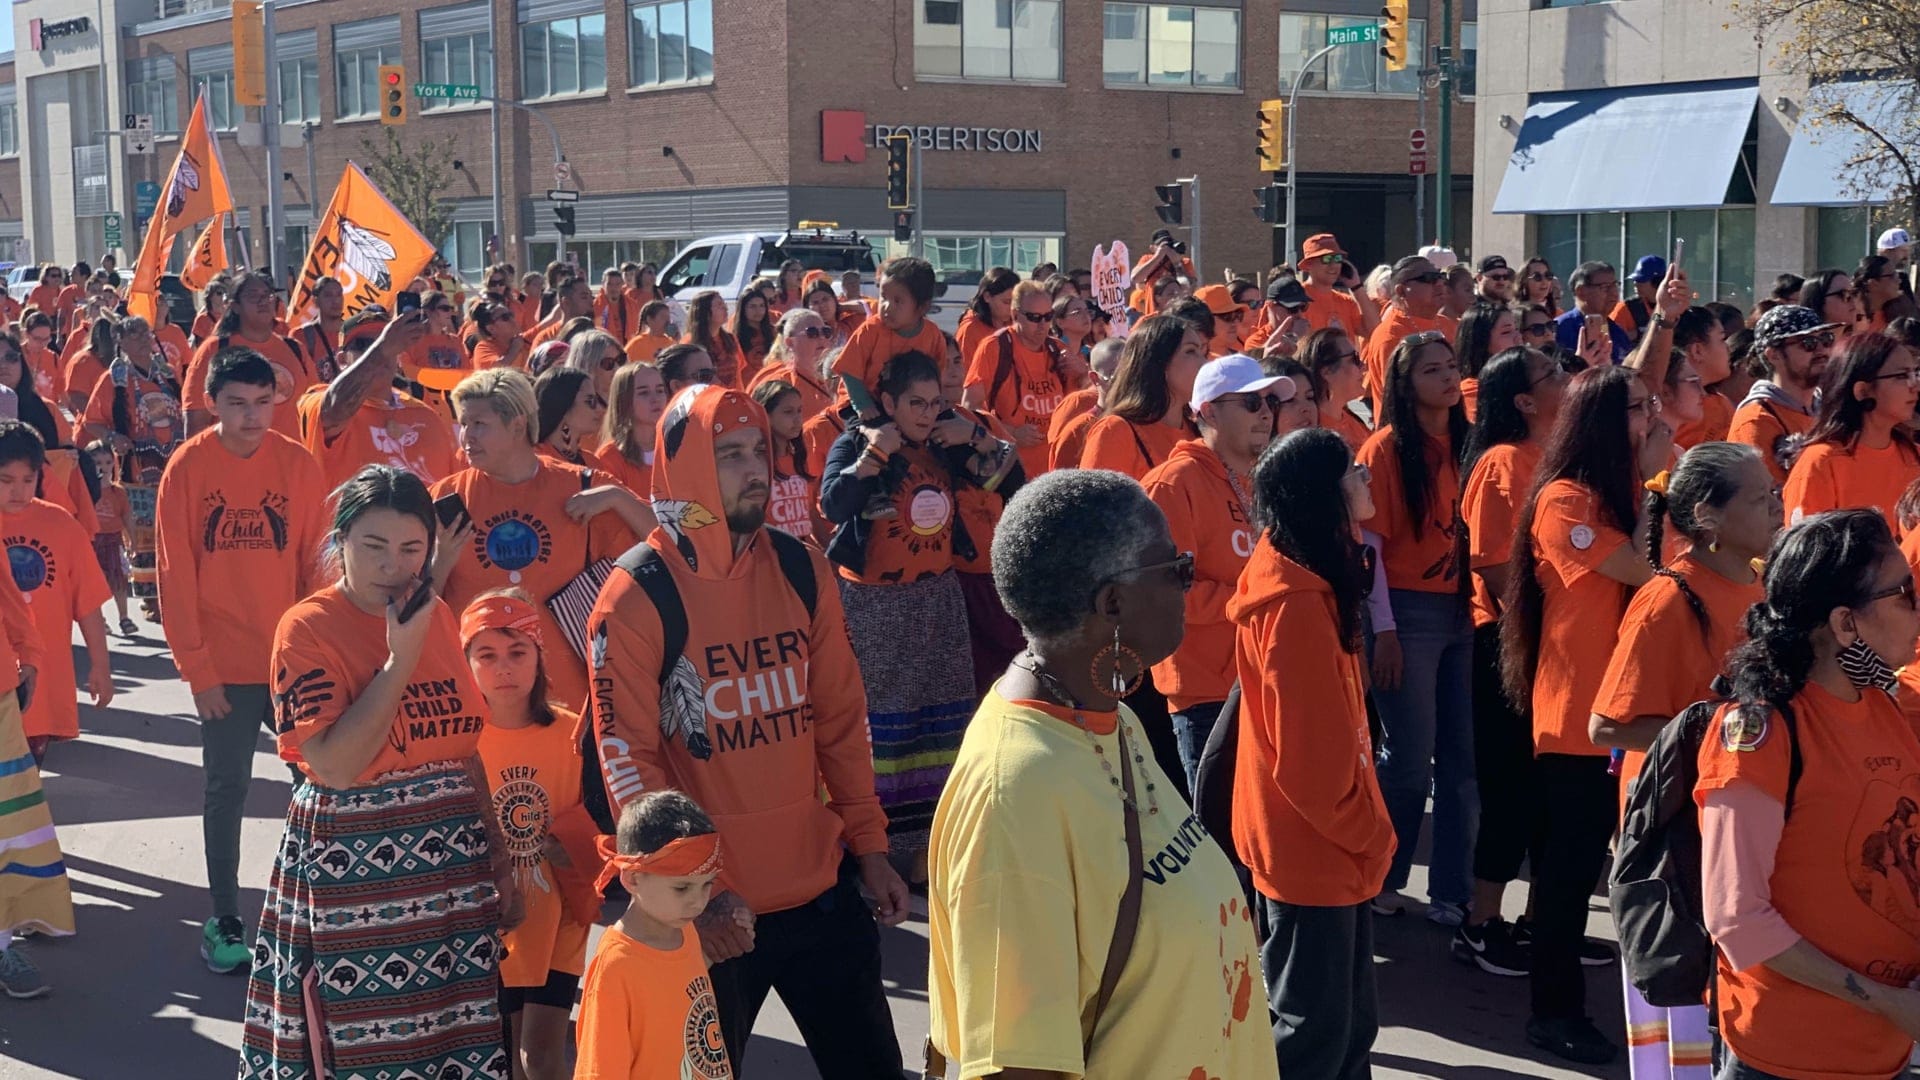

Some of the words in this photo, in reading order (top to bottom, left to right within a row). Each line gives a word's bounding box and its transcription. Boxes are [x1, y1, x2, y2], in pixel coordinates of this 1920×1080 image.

[1329, 28, 1358, 44] Main
[1364, 26, 1377, 41] St
[416, 85, 447, 97] York
[454, 86, 478, 98] Ave
[1100, 267, 1123, 287] EVERY
[1099, 286, 1124, 305] CHILD
[771, 475, 808, 501] EVER
[226, 508, 262, 520] EVERY
[485, 509, 518, 528] CHILD
[772, 500, 809, 522] CHIL
[221, 520, 264, 539] Child
[217, 539, 273, 551] MATTERS
[705, 661, 809, 720] CHIL
[404, 697, 463, 719] CHILD
[593, 678, 616, 736] EVERY
[409, 716, 484, 741] MATTER
[500, 766, 538, 782] EVERY
